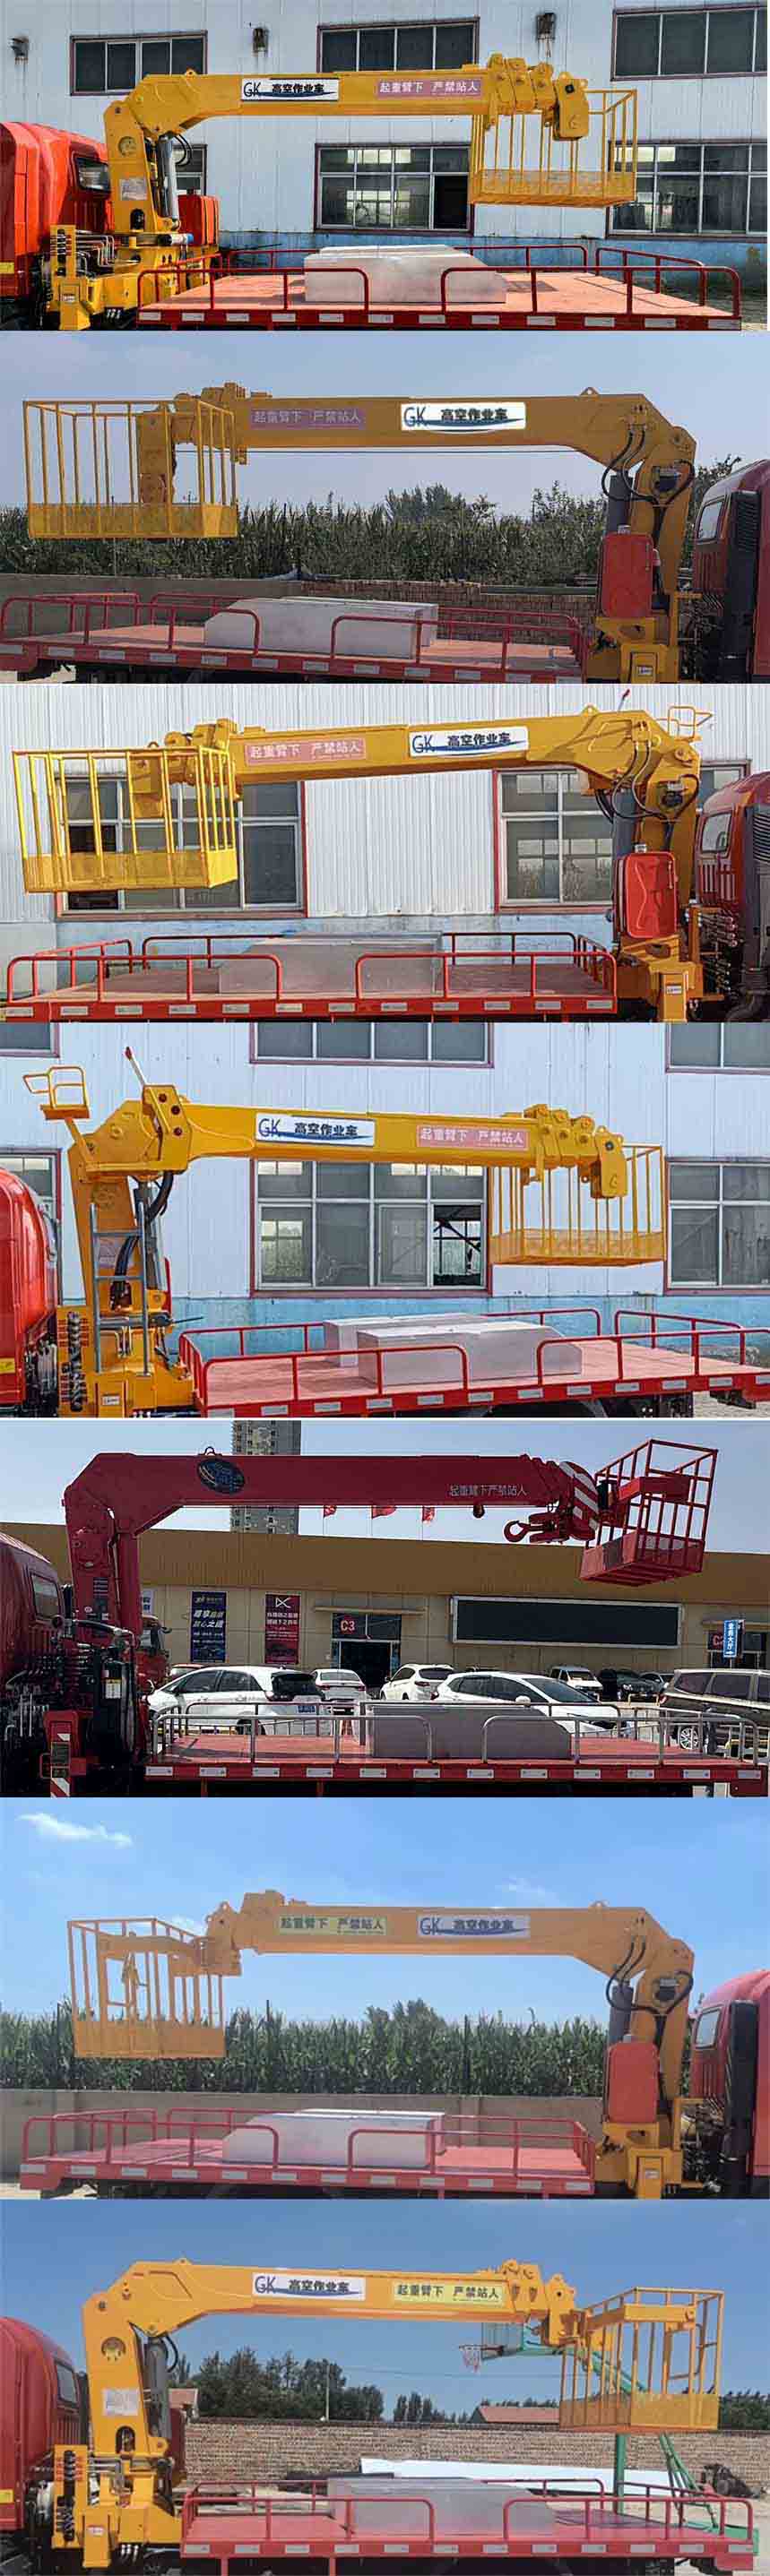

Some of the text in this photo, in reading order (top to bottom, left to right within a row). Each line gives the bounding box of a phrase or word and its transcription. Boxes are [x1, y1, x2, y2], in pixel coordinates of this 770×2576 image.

[244, 82, 324, 97] GK 高空作业车
[403, 407, 508, 427] GK 高空作业车
[412, 732, 511, 754] GK 高空作业车
[258, 1118, 358, 1137] GK 高空作业车
[341, 1620, 355, 1631] C3
[420, 1917, 514, 1935] GK 高空作业车
[255, 2276, 350, 2294] GK 高空作业车
